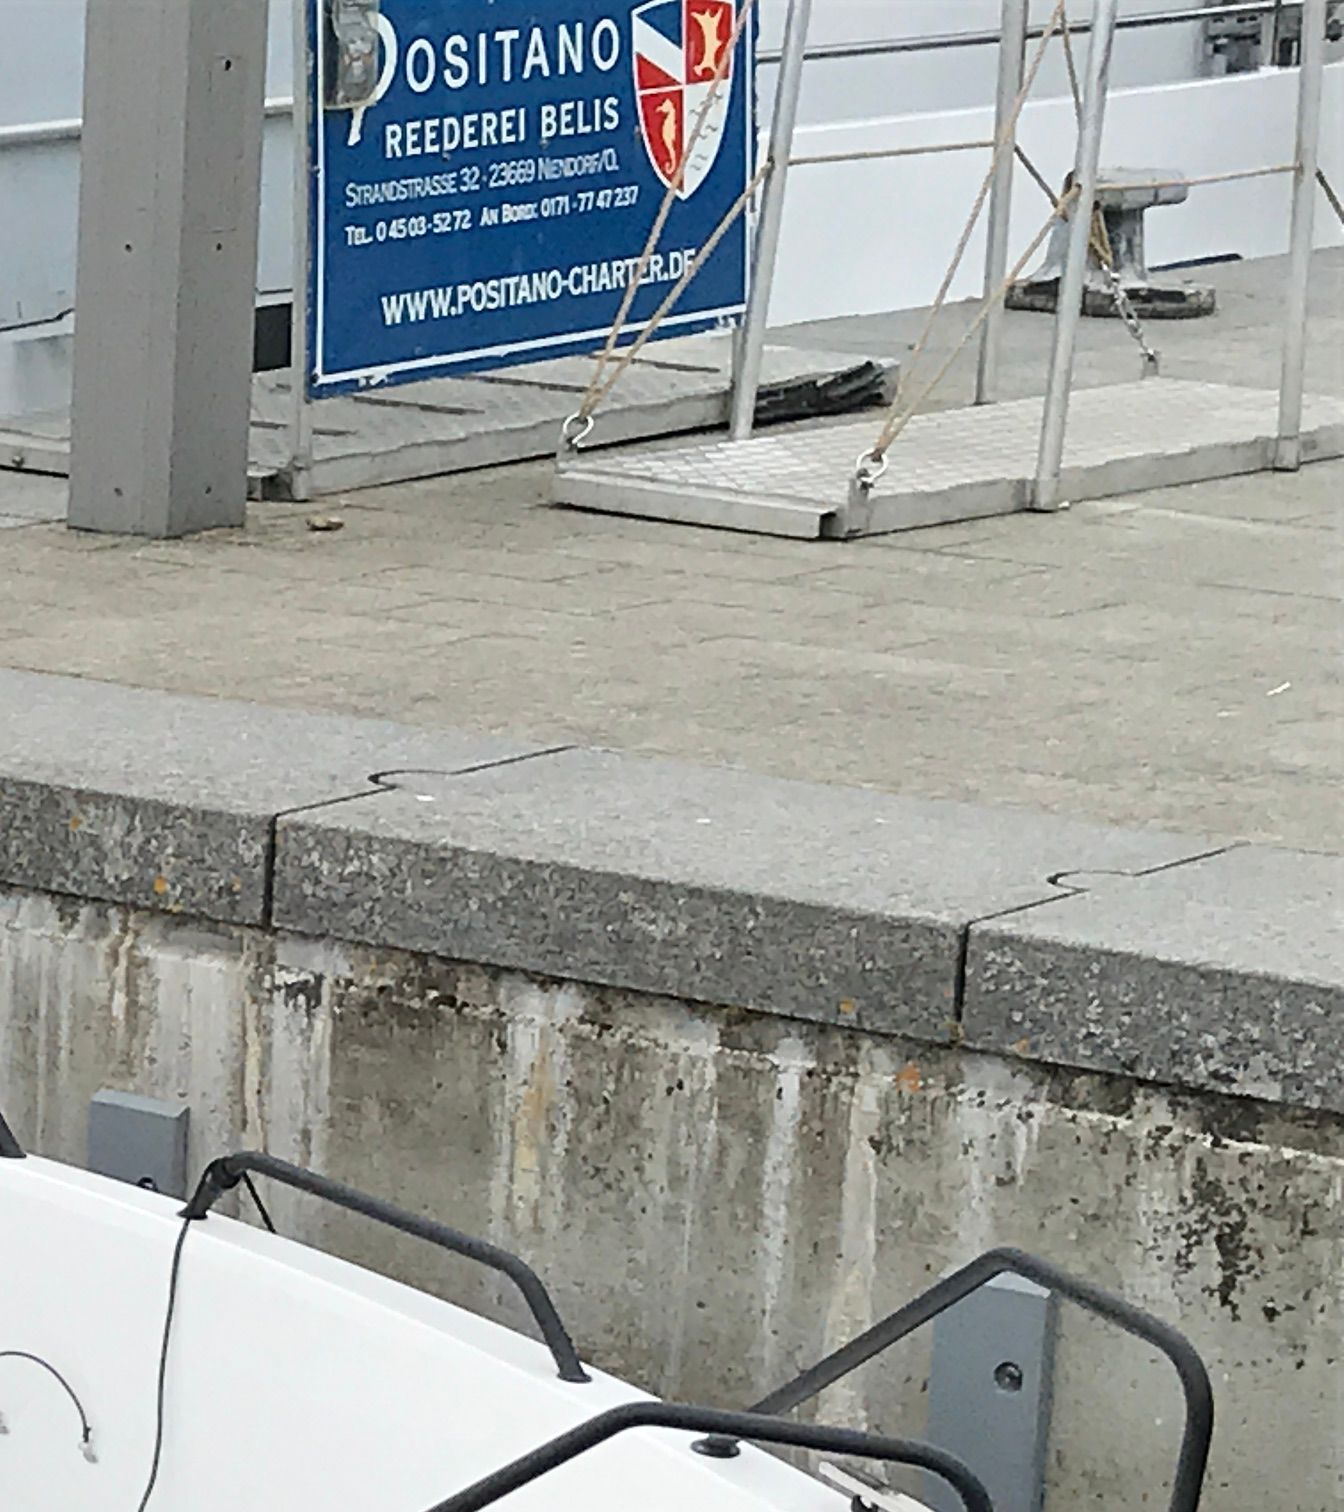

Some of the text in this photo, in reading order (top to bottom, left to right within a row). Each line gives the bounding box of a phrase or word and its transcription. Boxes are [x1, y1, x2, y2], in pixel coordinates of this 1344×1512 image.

[384, 96, 620, 159] REEDEREI BELIS
[459, 165, 481, 193] 32
